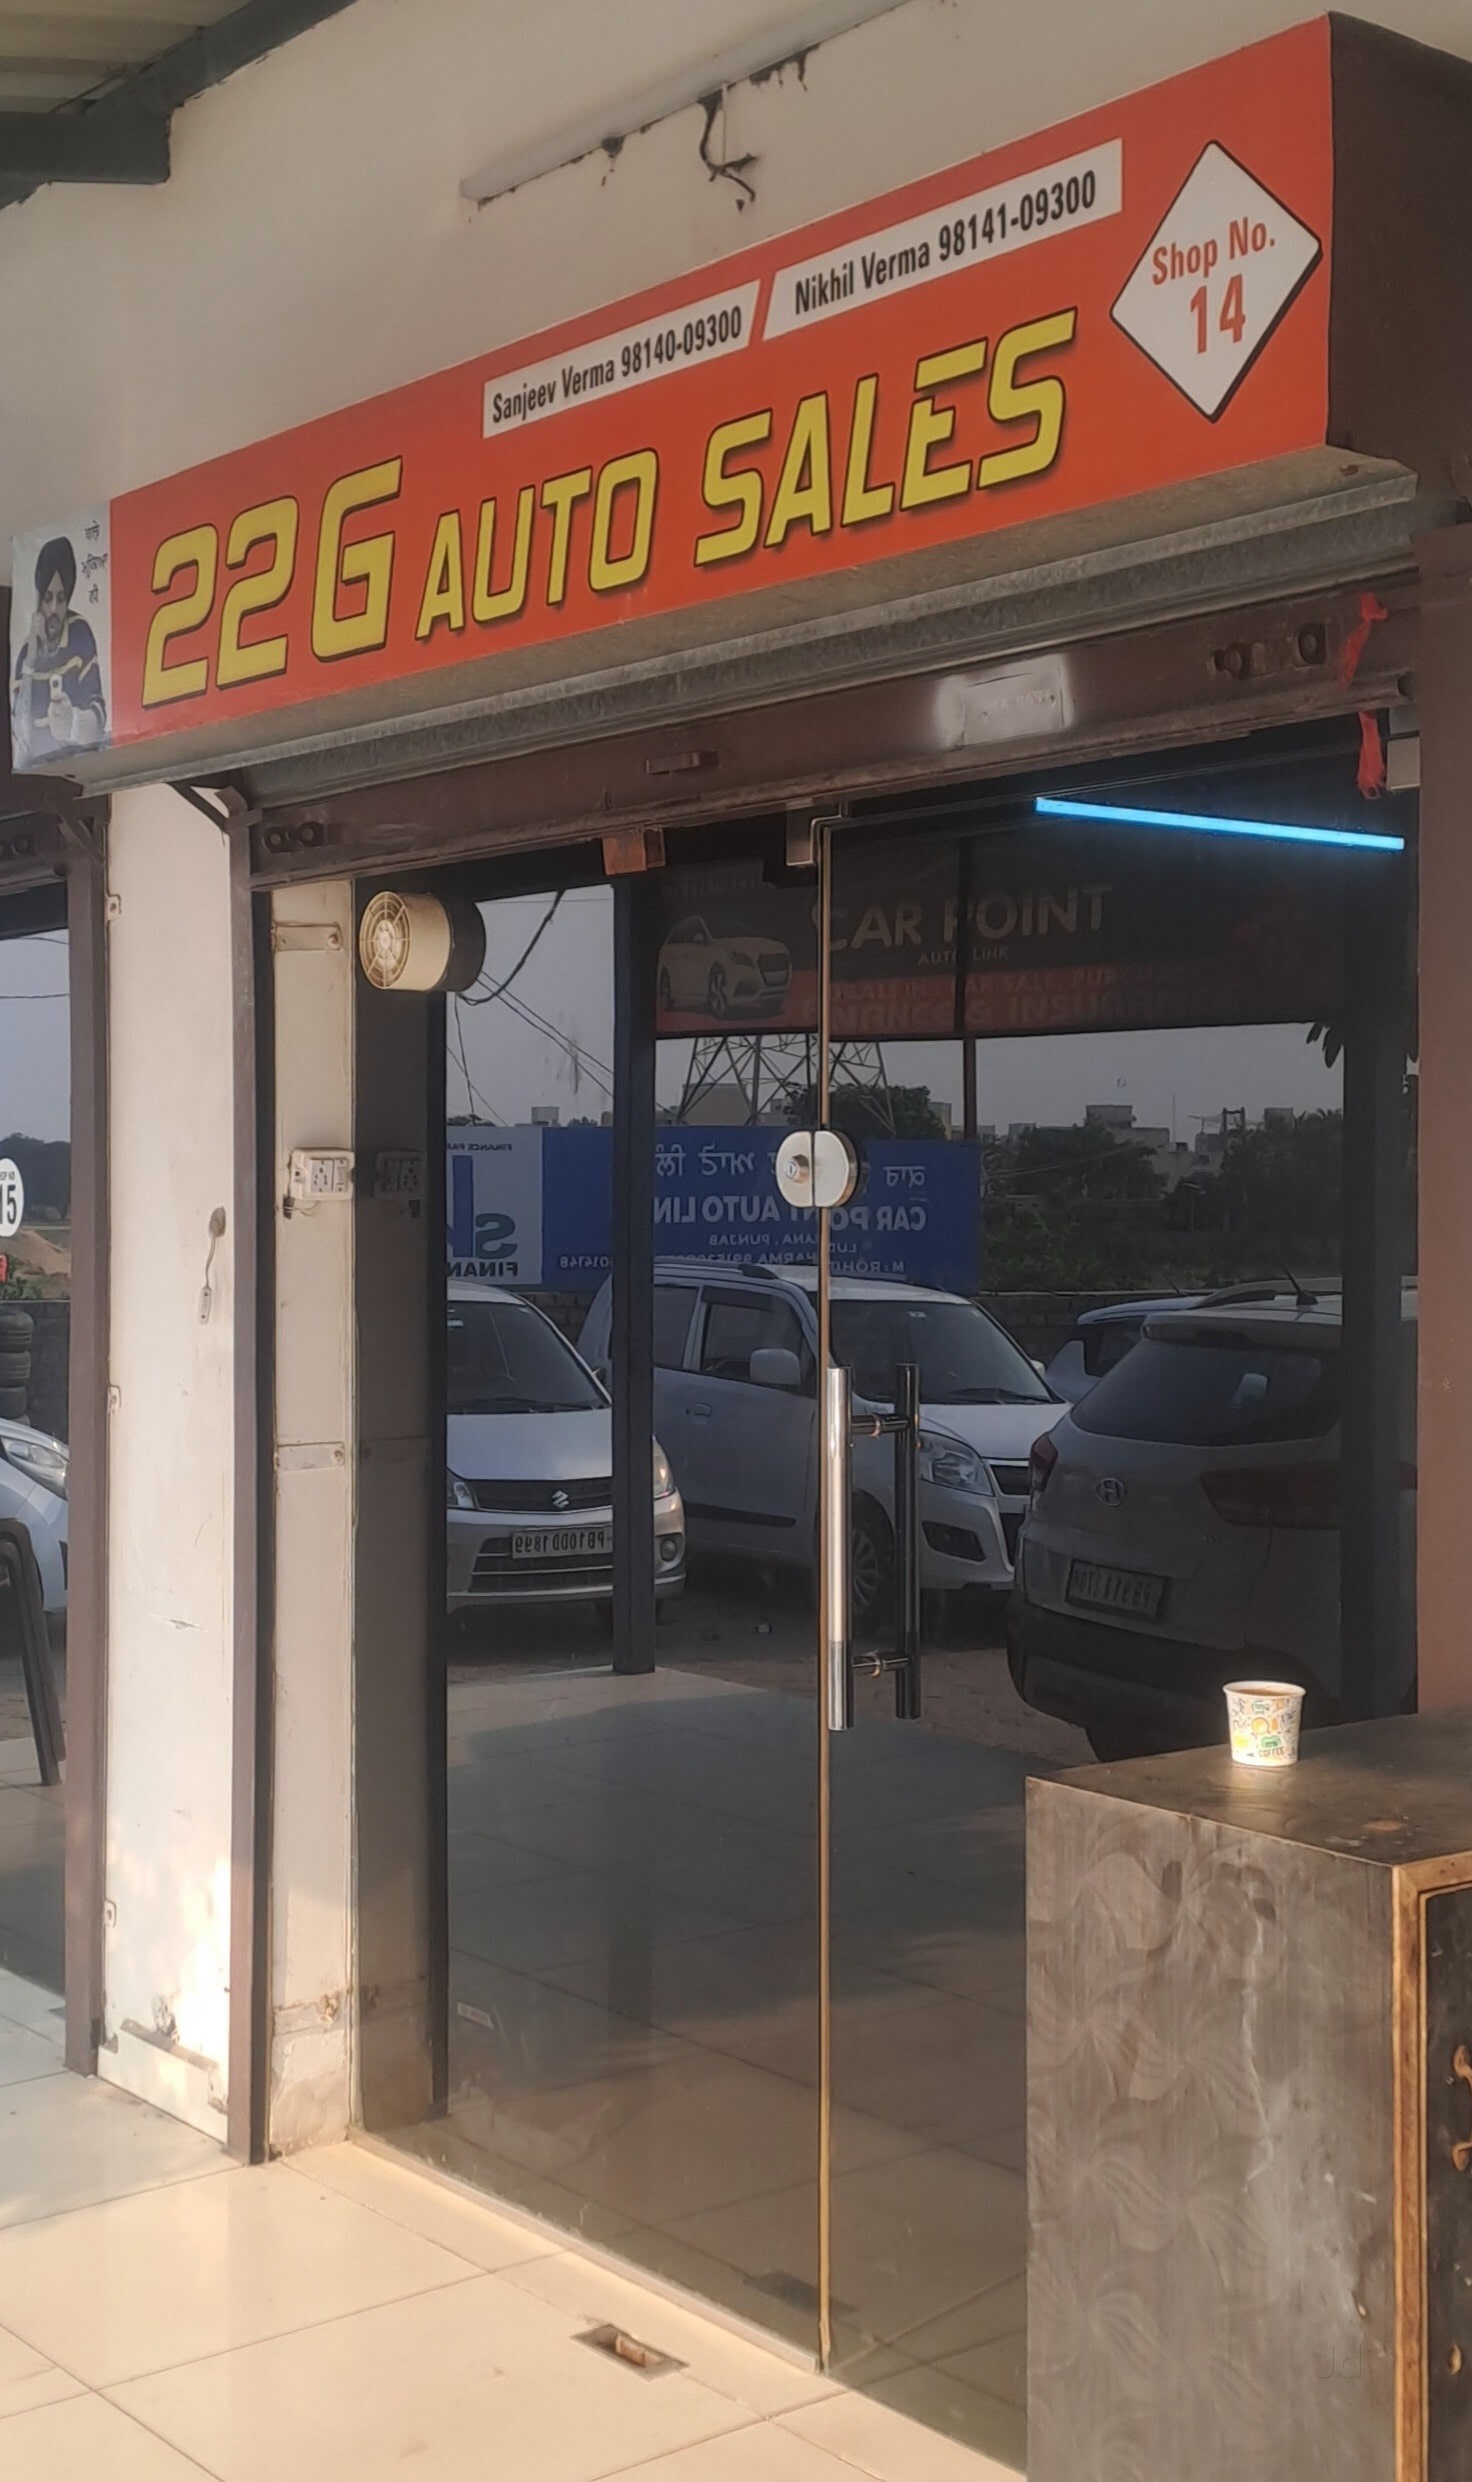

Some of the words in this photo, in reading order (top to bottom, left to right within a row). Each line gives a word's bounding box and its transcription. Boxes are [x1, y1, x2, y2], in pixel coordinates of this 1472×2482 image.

[794, 260, 854, 316] Nikhil
[861, 240, 930, 292] Verma
[938, 169, 1096, 263] 98141-09300
[1152, 236, 1217, 290] Shop
[1231, 217, 1276, 262] No.
[492, 378, 557, 428] Sanjeev
[561, 361, 614, 402] Verma
[621, 304, 742, 378] 98140-09300
[1190, 275, 1246, 355] 14
[415, 447, 659, 640] AUTO
[693, 307, 1078, 568] SALES
[0, 1184, 17, 1225] 15
